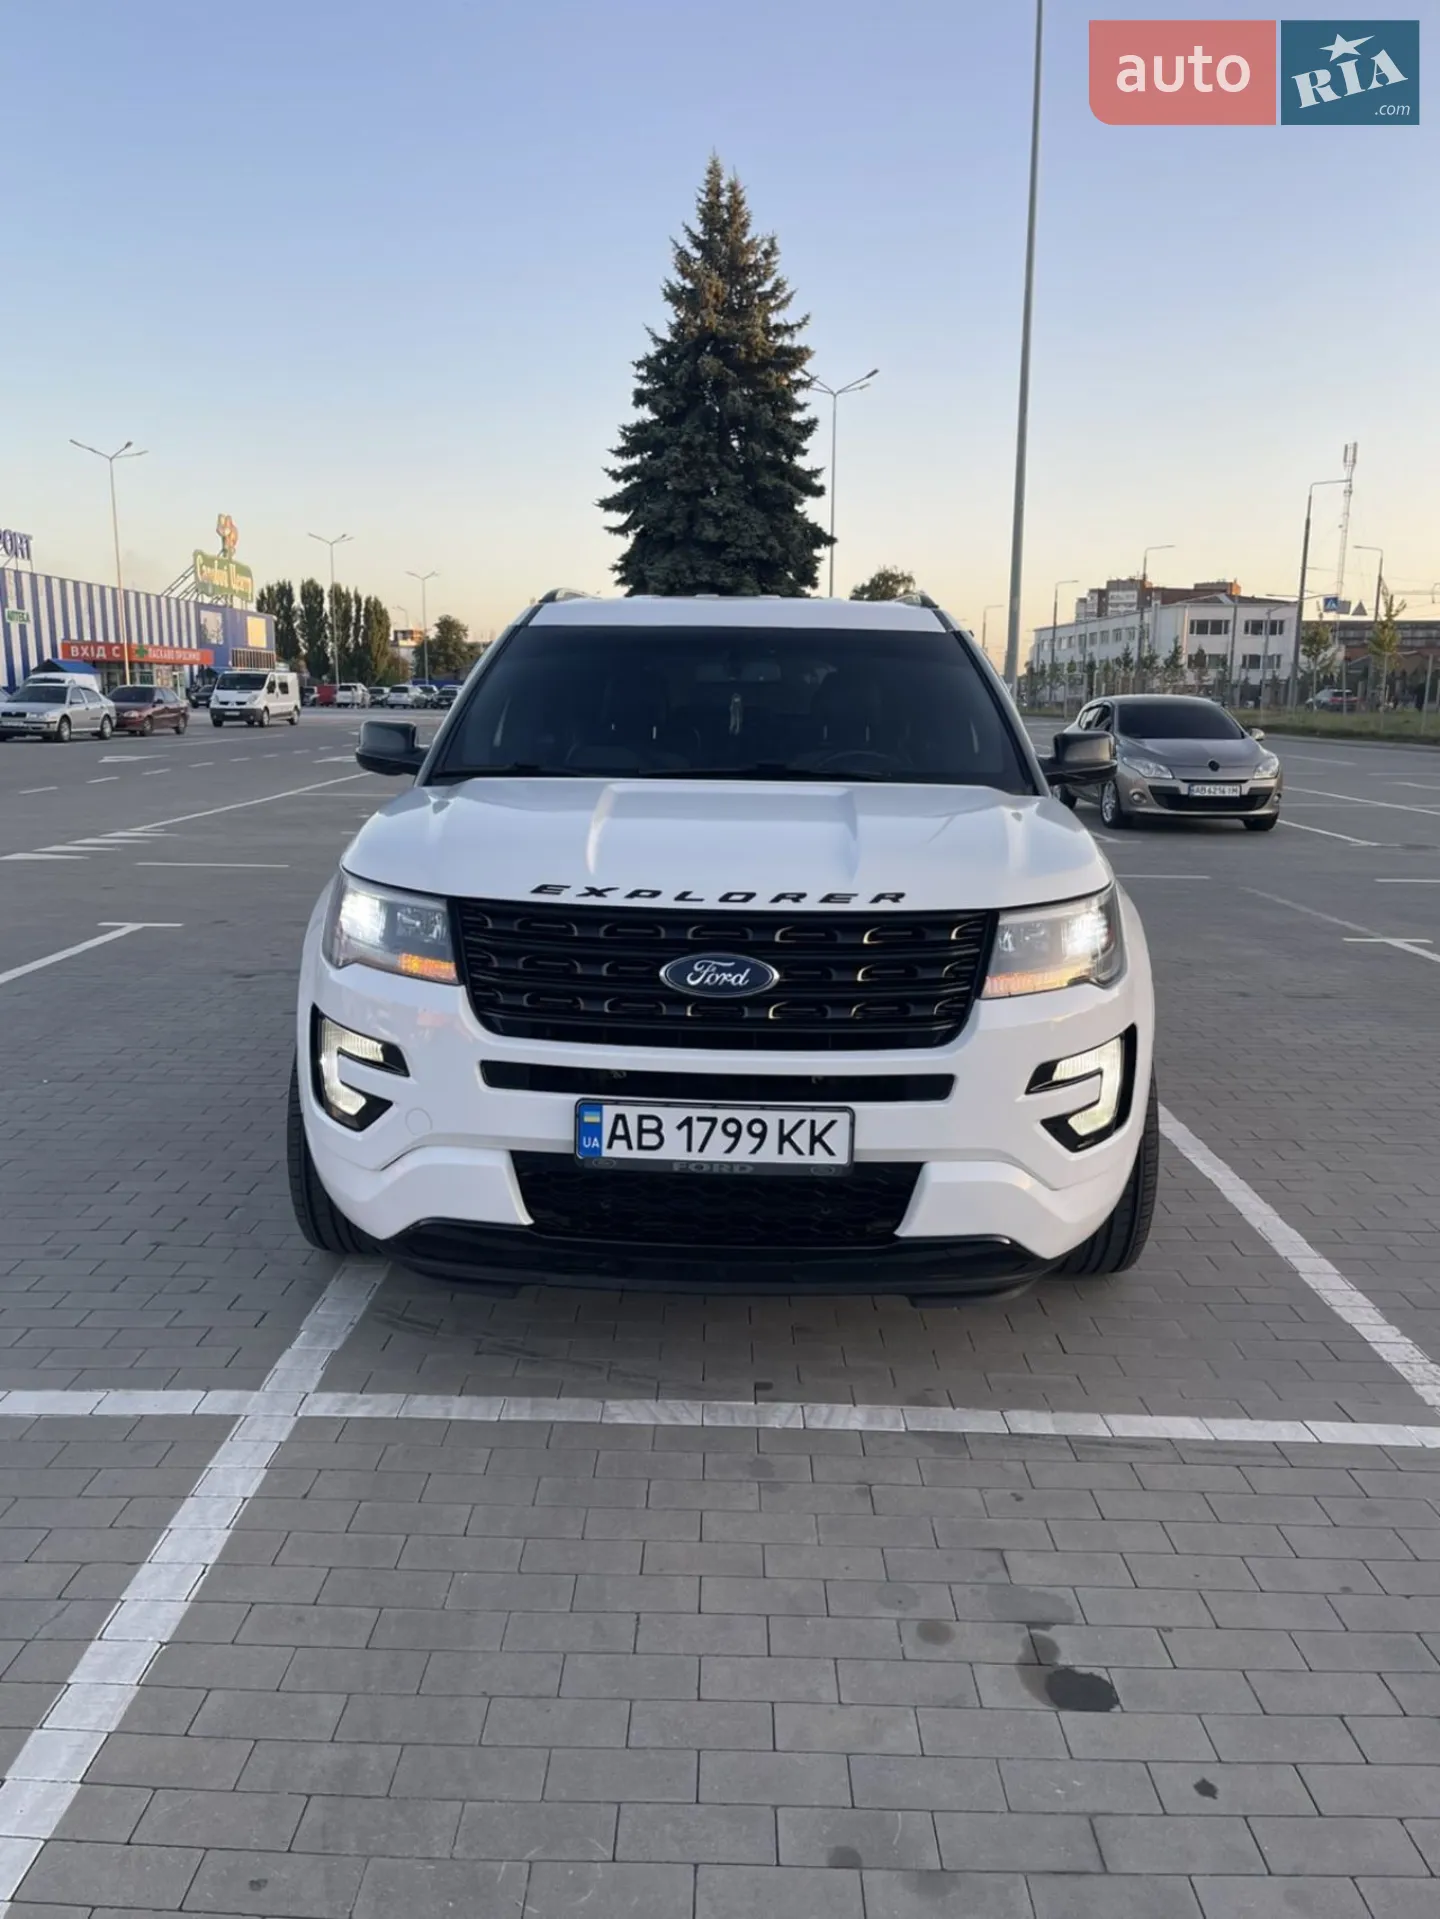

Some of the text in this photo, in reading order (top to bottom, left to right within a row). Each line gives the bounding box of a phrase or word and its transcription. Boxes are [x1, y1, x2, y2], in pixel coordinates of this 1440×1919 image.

[71, 645, 107, 659] ВХІД
[530, 884, 906, 904] EXPLORER
[686, 959, 750, 987] Ford
[582, 1137, 600, 1148] UA
[606, 1113, 839, 1156] AB 1799 KK
[671, 1160, 755, 1174] FORD
